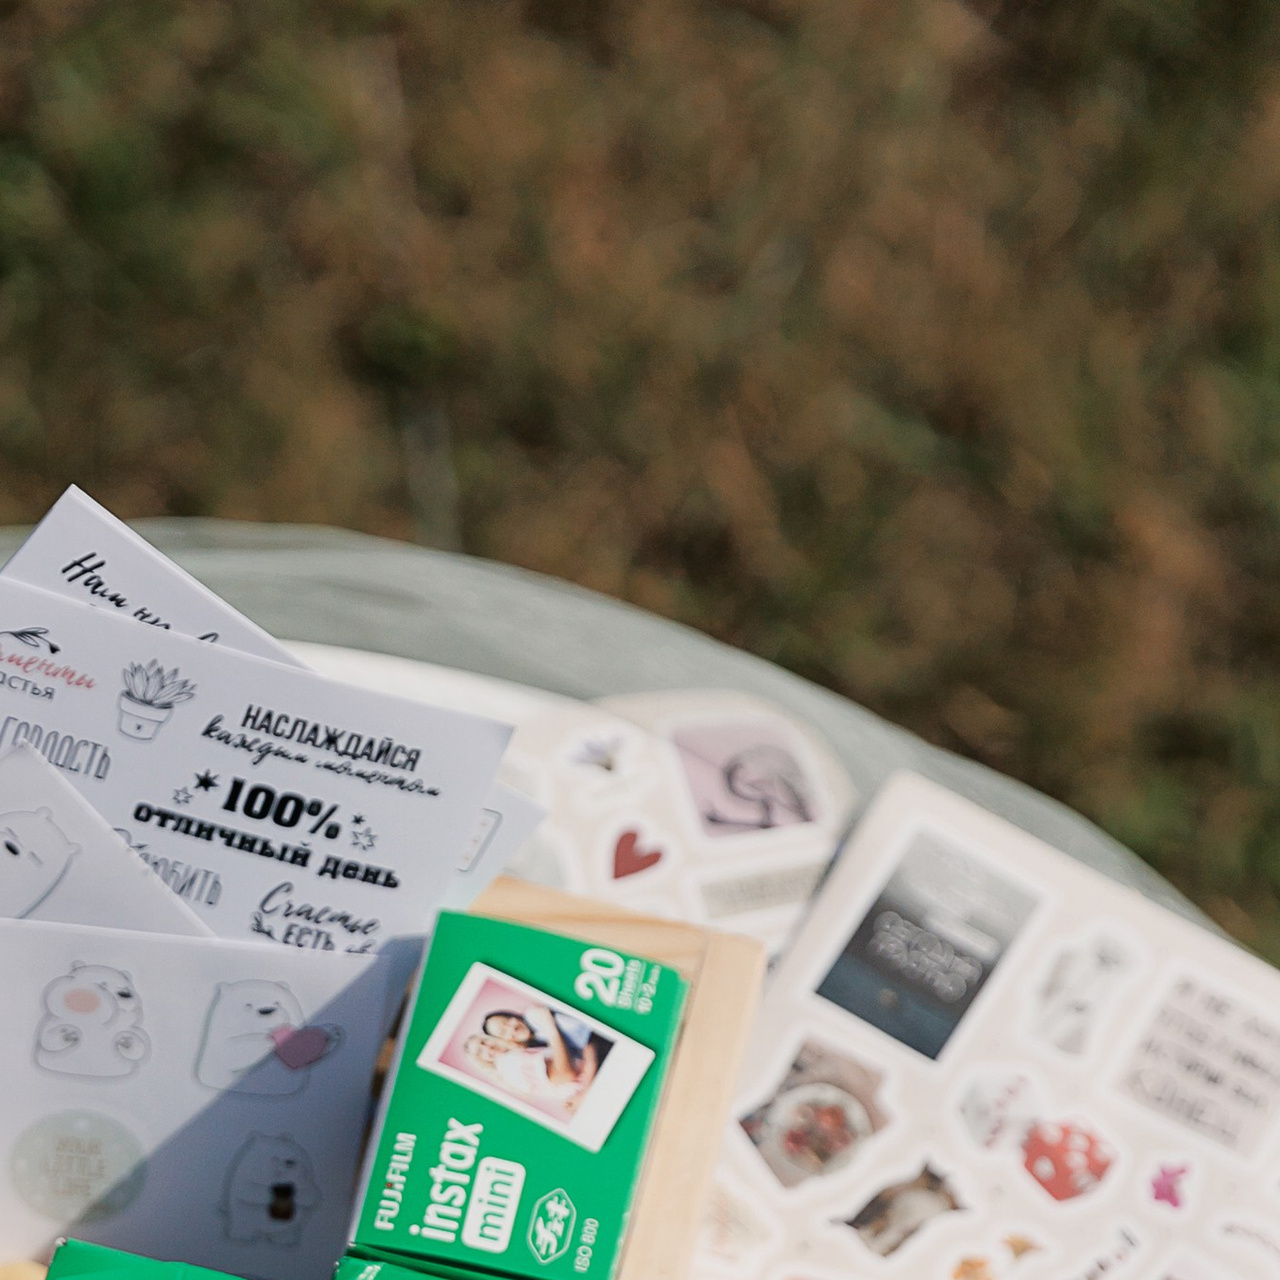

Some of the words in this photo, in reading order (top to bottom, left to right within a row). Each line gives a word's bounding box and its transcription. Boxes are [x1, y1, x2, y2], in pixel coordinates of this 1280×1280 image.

[201, 714, 308, 765] каждым
[241, 704, 422, 772] НАСЛАЖДАЙСЯ
[222, 776, 342, 840] 100%
[133, 801, 310, 868] отличный
[317, 851, 401, 890] день
[260, 881, 379, 935] Счастье
[282, 923, 336, 951] ЕСТЬ
[574, 948, 625, 1007] 20
[374, 1132, 417, 1231] FUJIFILM
[409, 1117, 484, 1243] instax
[477, 1165, 516, 1243] mini
[574, 1245, 593, 1273] ISO
[581, 1217, 599, 1245] 800
